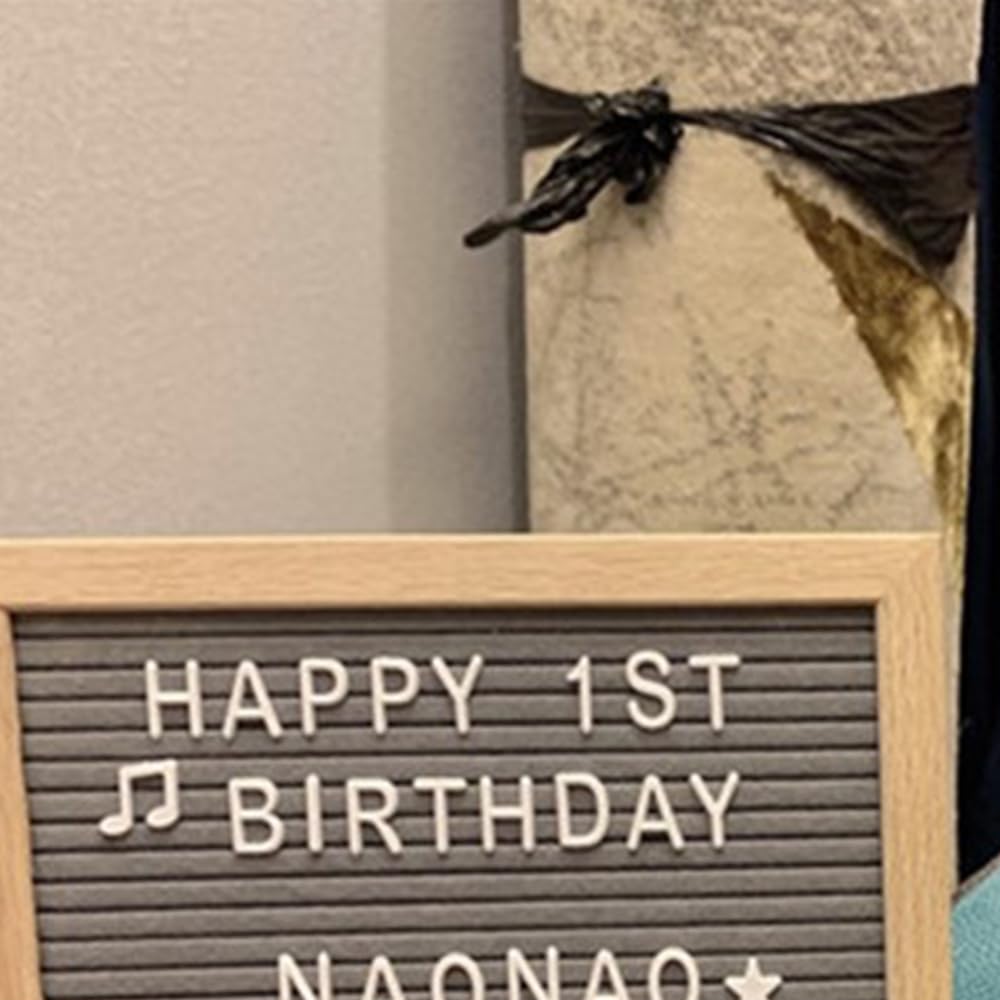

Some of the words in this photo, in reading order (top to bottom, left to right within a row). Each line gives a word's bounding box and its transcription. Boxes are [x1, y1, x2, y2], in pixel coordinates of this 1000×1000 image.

[144, 653, 484, 740] HAPPY
[565, 649, 741, 734] 1ST
[227, 770, 740, 855] BIRTHDAY
